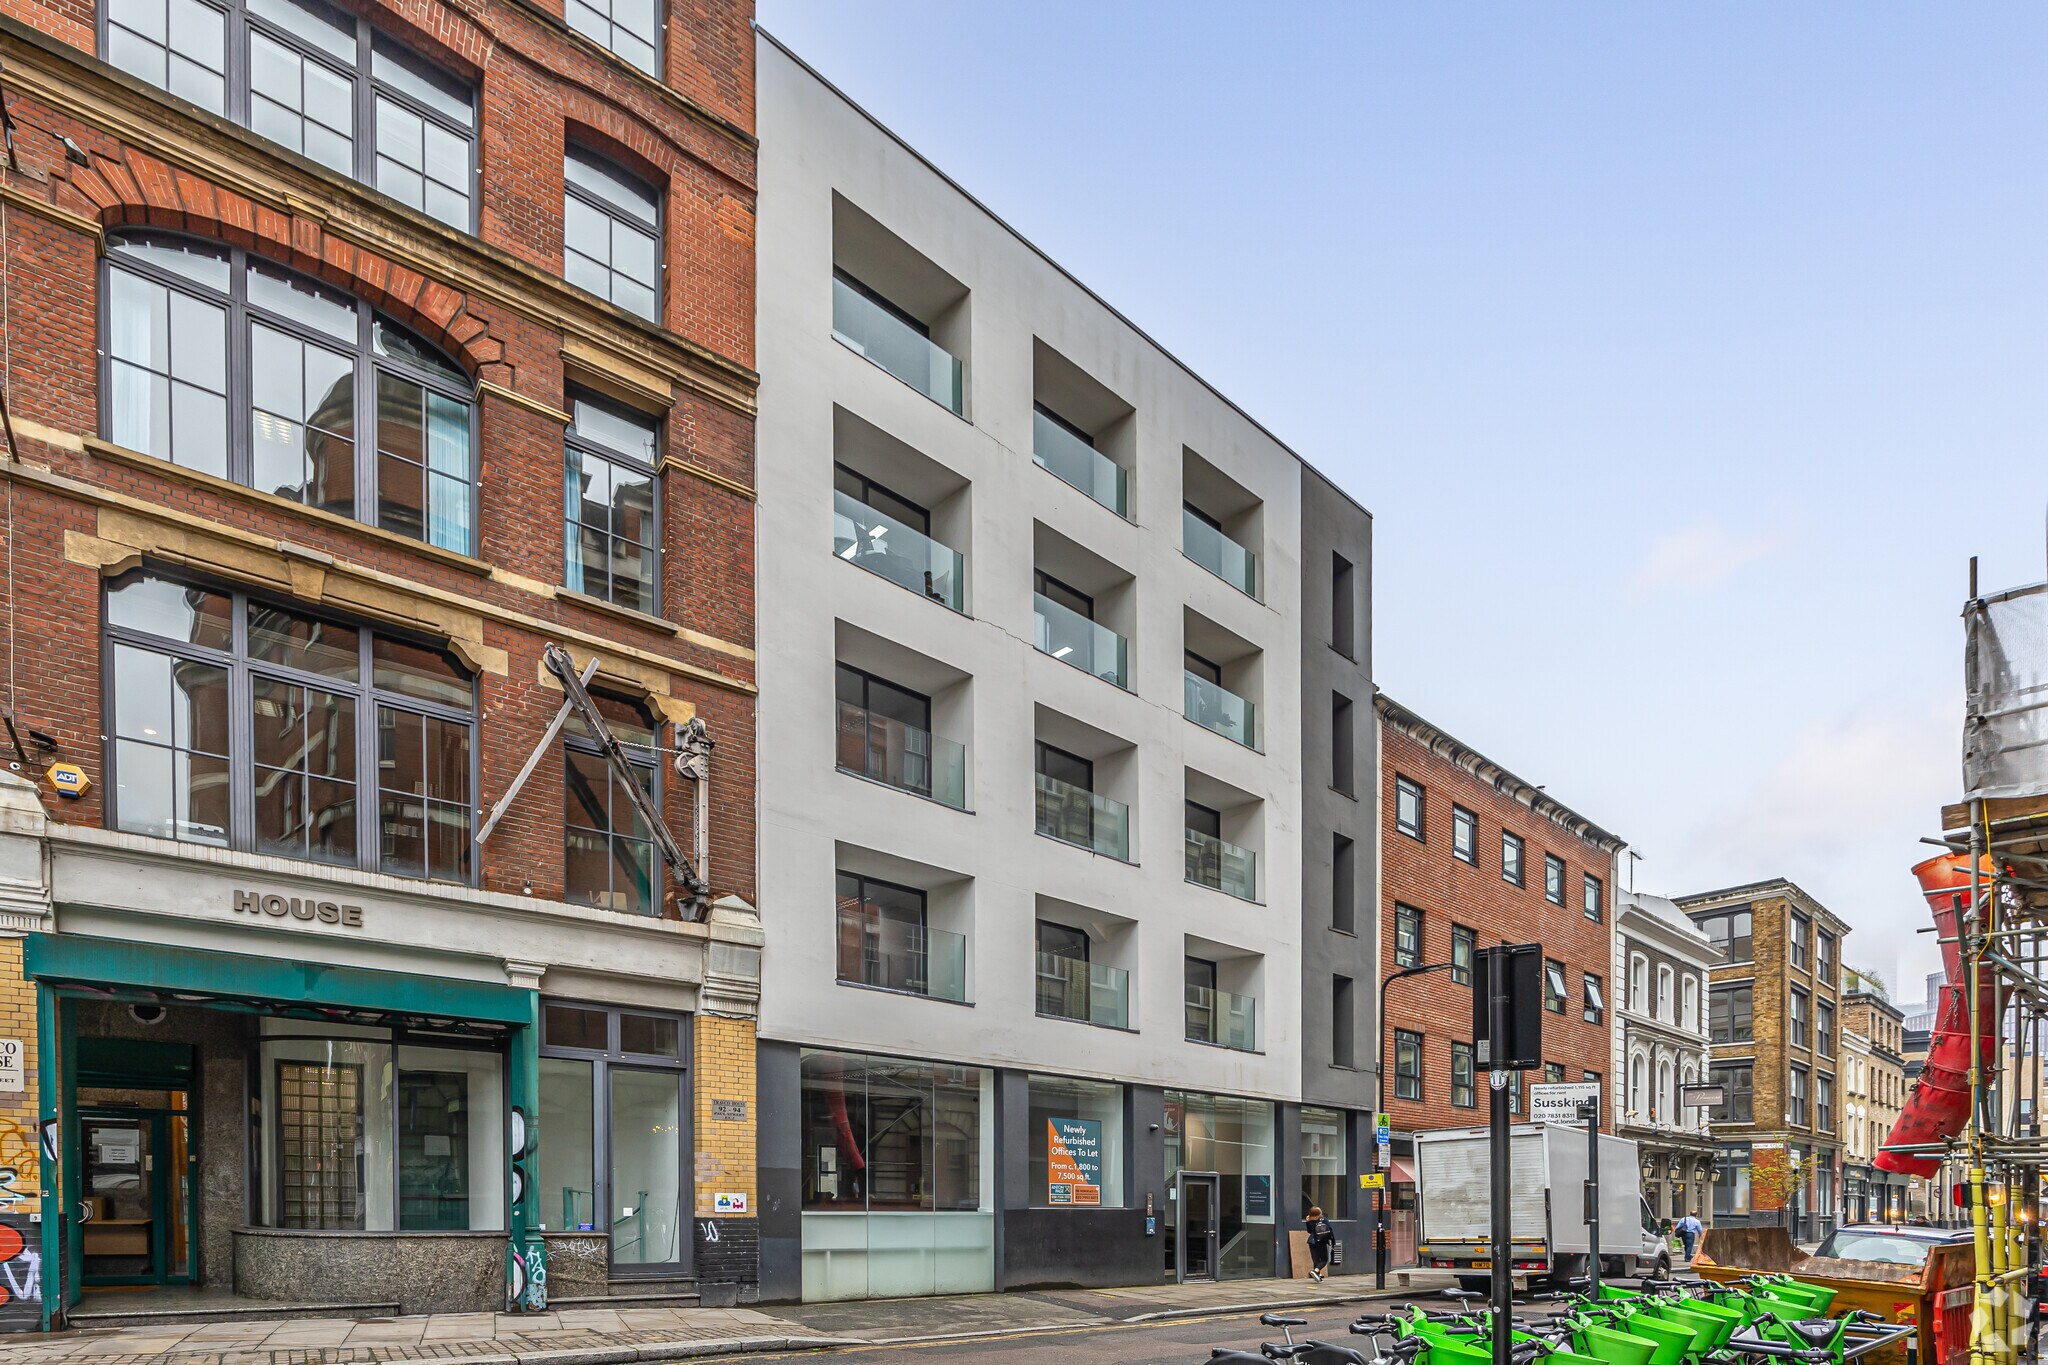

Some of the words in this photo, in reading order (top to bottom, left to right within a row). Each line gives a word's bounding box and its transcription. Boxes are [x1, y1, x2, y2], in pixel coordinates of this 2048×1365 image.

[57, 772, 77, 782] ADT
[234, 890, 362, 927] HOUSE
[1063, 1124, 1087, 1136] Newly
[1053, 1136, 1096, 1146] Refurbished
[1051, 1146, 1077, 1156] Offices
[1078, 1148, 1086, 1156] To
[1087, 1149, 1098, 1157] Let
[1051, 1162, 1067, 1170] From
[1057, 1172, 1075, 1180] 7,500
[1076, 1174, 1084, 1182] sq
